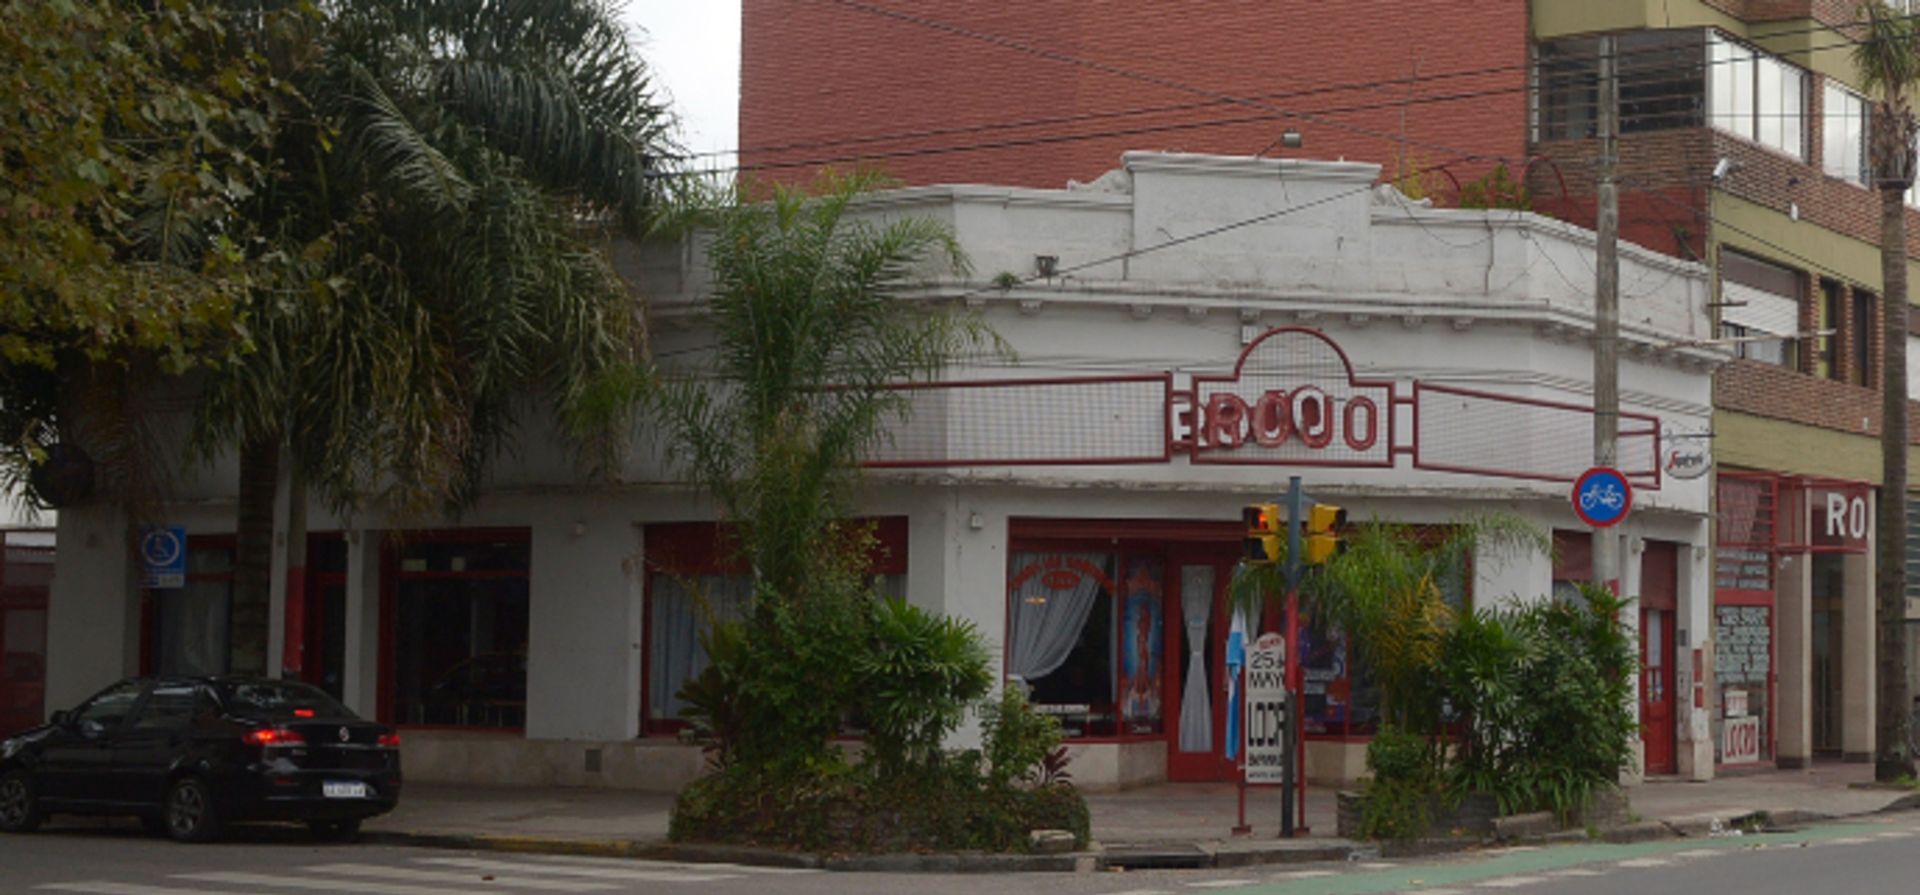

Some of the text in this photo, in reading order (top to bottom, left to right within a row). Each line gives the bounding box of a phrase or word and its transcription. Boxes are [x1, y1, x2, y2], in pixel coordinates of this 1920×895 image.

[1826, 492, 1871, 540] RO
[1251, 651, 1275, 669] 25
[1249, 671, 1286, 688] MAY
[1248, 702, 1287, 747] LOCR
